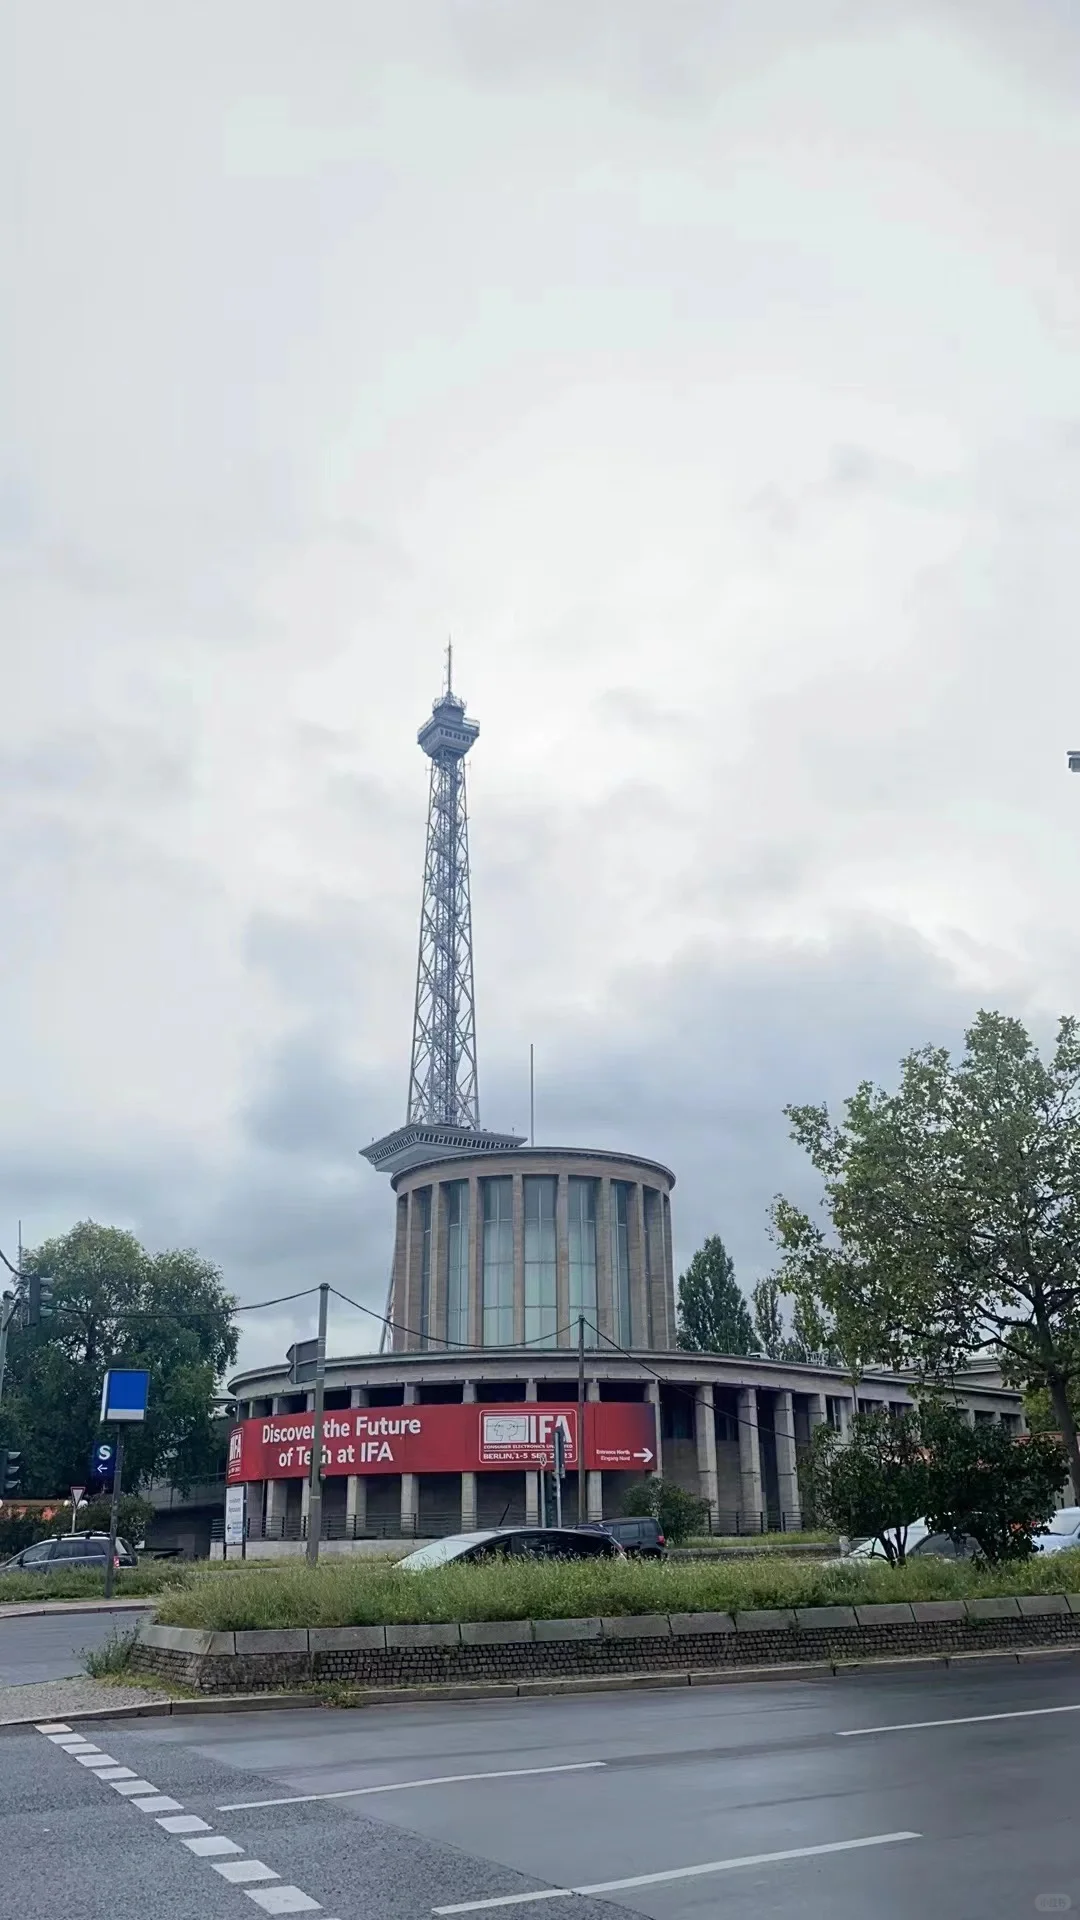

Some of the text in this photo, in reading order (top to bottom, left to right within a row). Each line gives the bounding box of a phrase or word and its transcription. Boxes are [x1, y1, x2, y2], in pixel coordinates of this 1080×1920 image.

[322, 1418, 350, 1438] the
[355, 1416, 421, 1436] Future
[530, 1415, 572, 1443] IFA
[99, 1445, 111, 1460] S
[278, 1442, 394, 1467] of Teh at IFA
